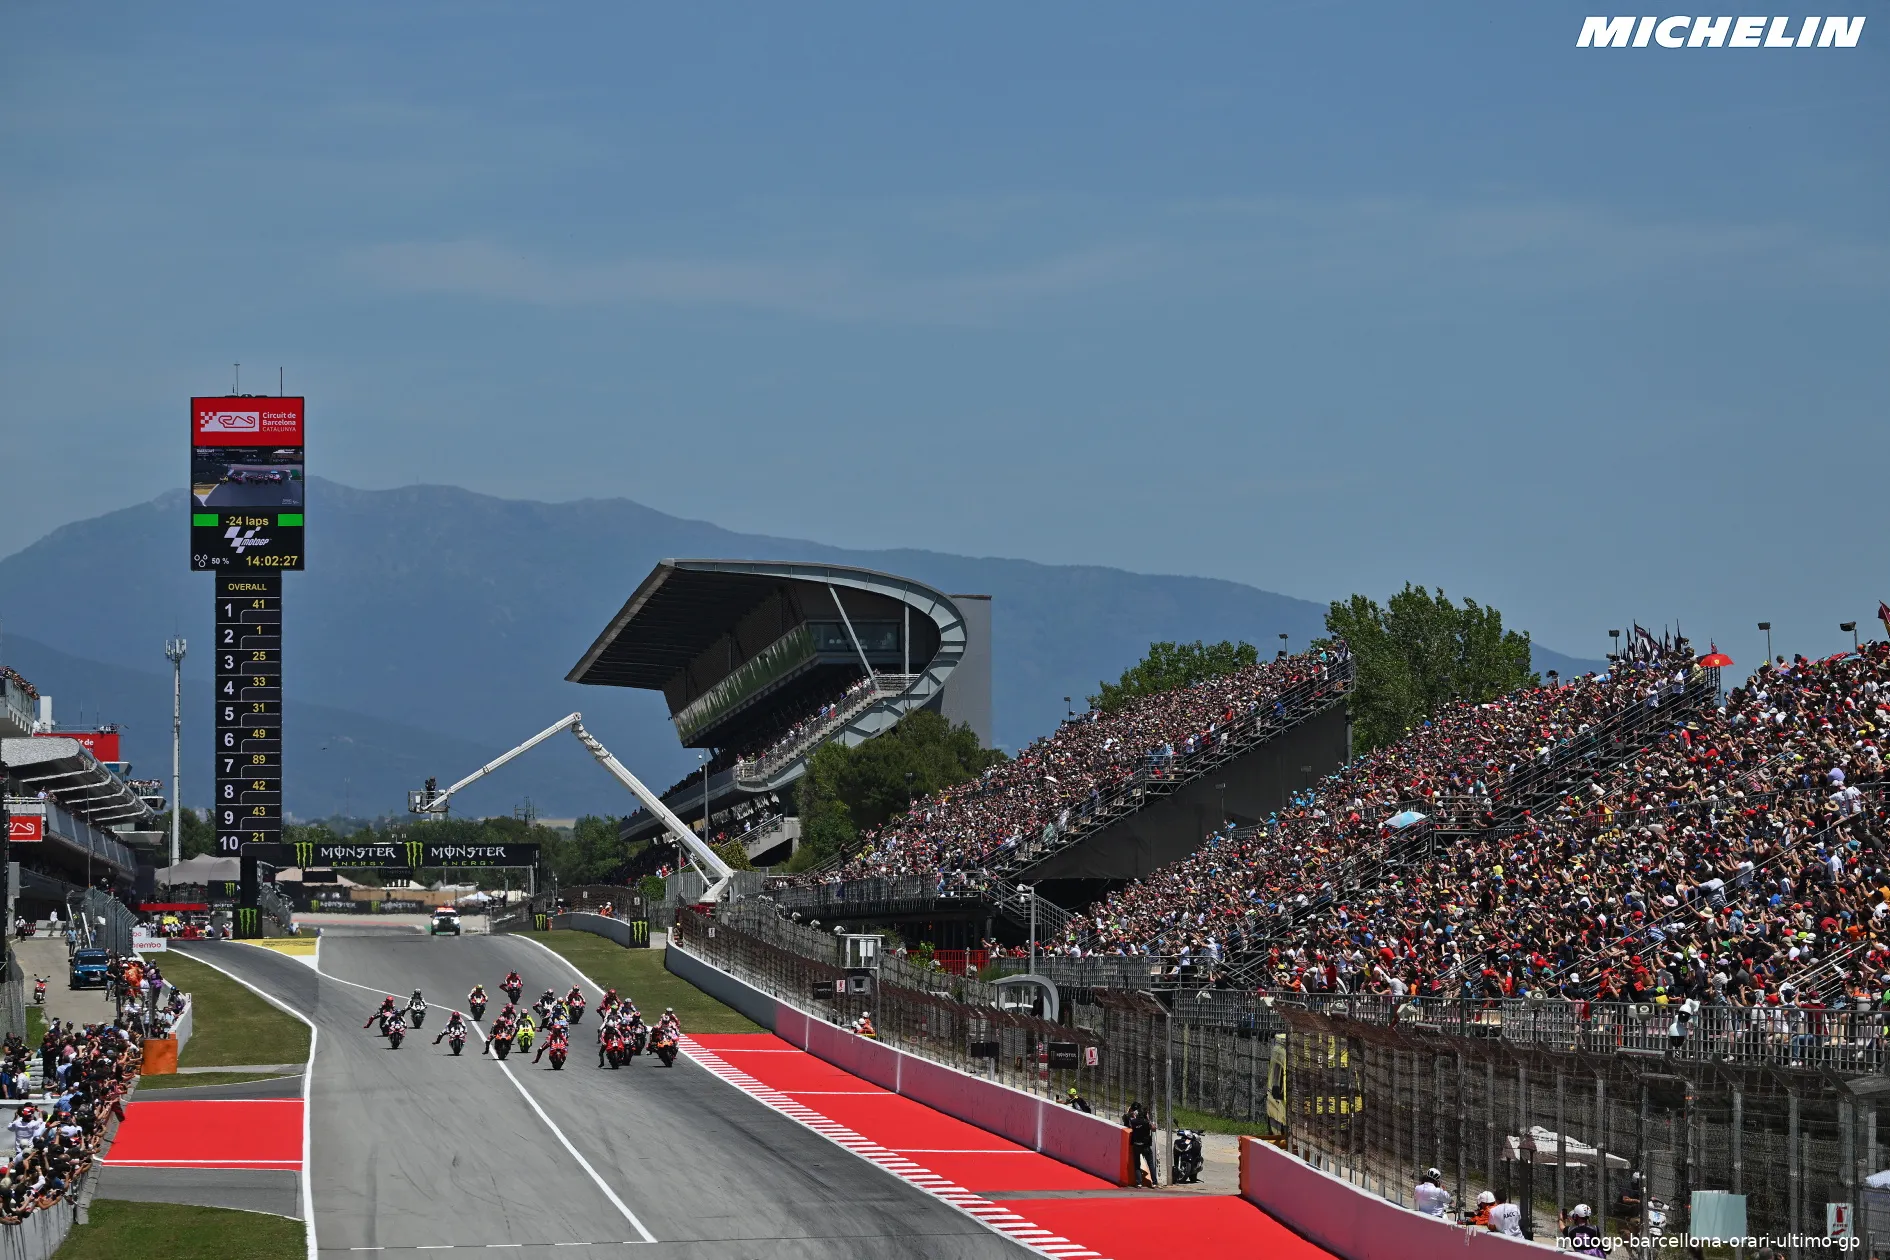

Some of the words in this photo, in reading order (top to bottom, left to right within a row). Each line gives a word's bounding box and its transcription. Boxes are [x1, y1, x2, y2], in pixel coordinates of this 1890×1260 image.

[225, 516, 242, 526] -24
[245, 516, 269, 527] laps
[246, 555, 298, 567] 14:02:27
[228, 583, 267, 591] OVERALL
[225, 603, 232, 617] 1
[252, 600, 265, 609] 41
[224, 629, 234, 643] 2
[256, 626, 262, 635] 1
[224, 655, 234, 669] 3
[252, 652, 266, 661] 25
[252, 677, 266, 686] 33
[224, 681, 234, 695] 4
[224, 707, 234, 721] 5
[252, 703, 265, 713] 31
[252, 729, 266, 738] 49
[224, 733, 234, 747] 6
[224, 758, 234, 773] 7
[252, 755, 266, 764] 89
[224, 784, 234, 799] 8
[252, 781, 266, 790] 42
[224, 810, 234, 825] 9
[252, 807, 266, 816] 43
[252, 832, 265, 842] 21
[219, 836, 239, 851] 10
[321, 846, 397, 859] MONSTER
[431, 846, 506, 859] MONSTER
